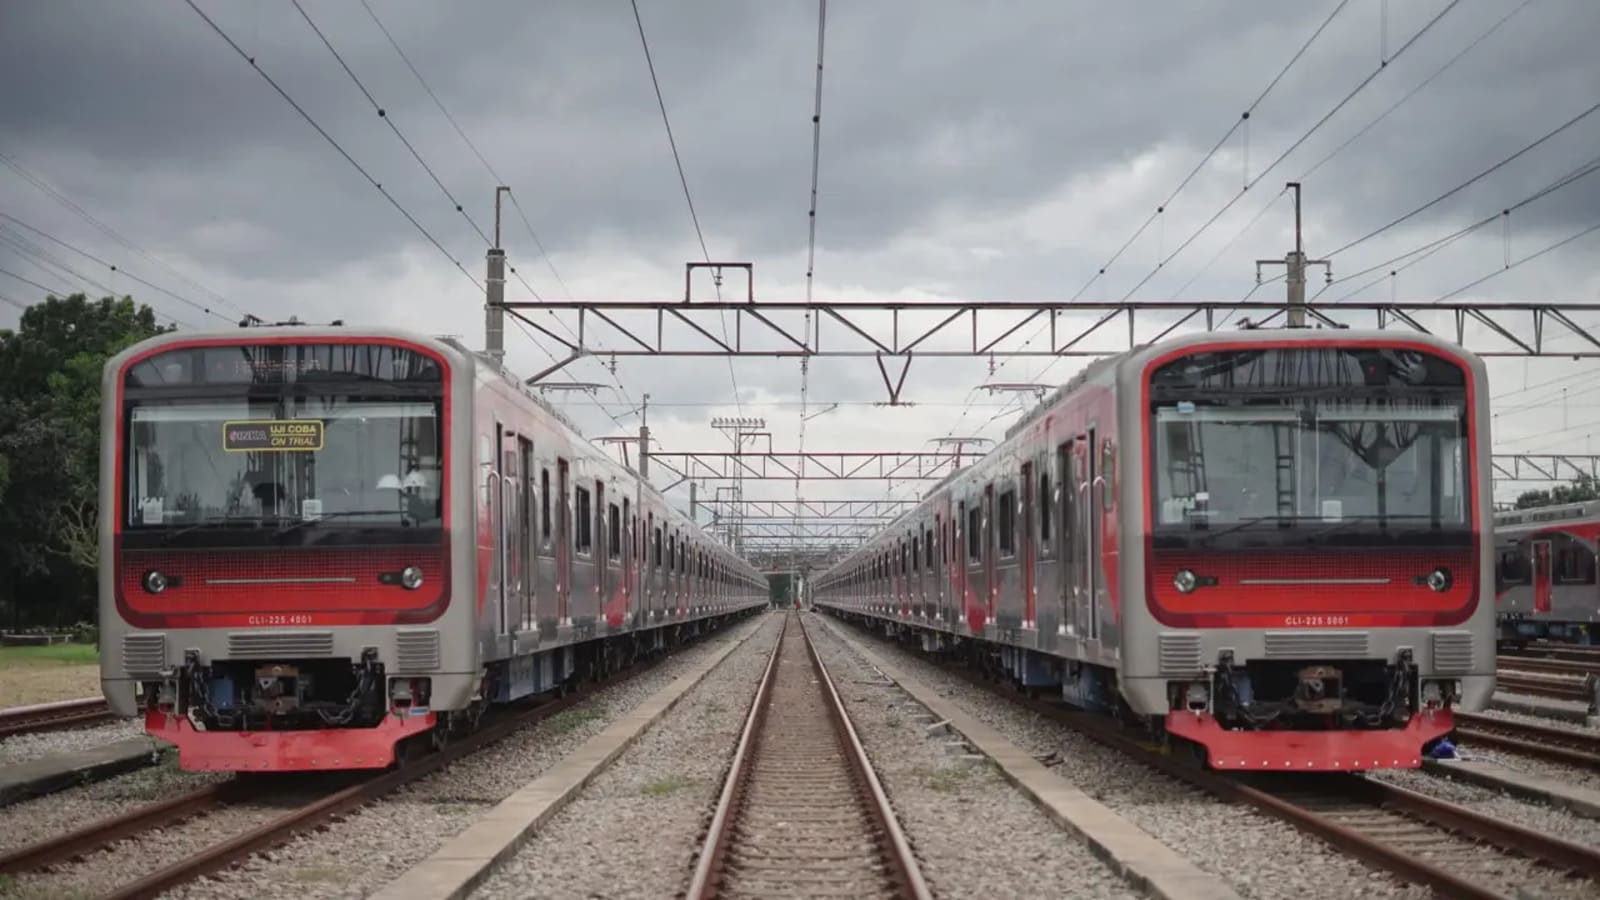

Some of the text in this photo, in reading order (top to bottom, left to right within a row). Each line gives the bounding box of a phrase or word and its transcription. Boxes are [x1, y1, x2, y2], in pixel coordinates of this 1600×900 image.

[270, 424, 316, 433] UJI COBA
[236, 430, 267, 441] INKA
[270, 437, 315, 446] ON TRIAL
